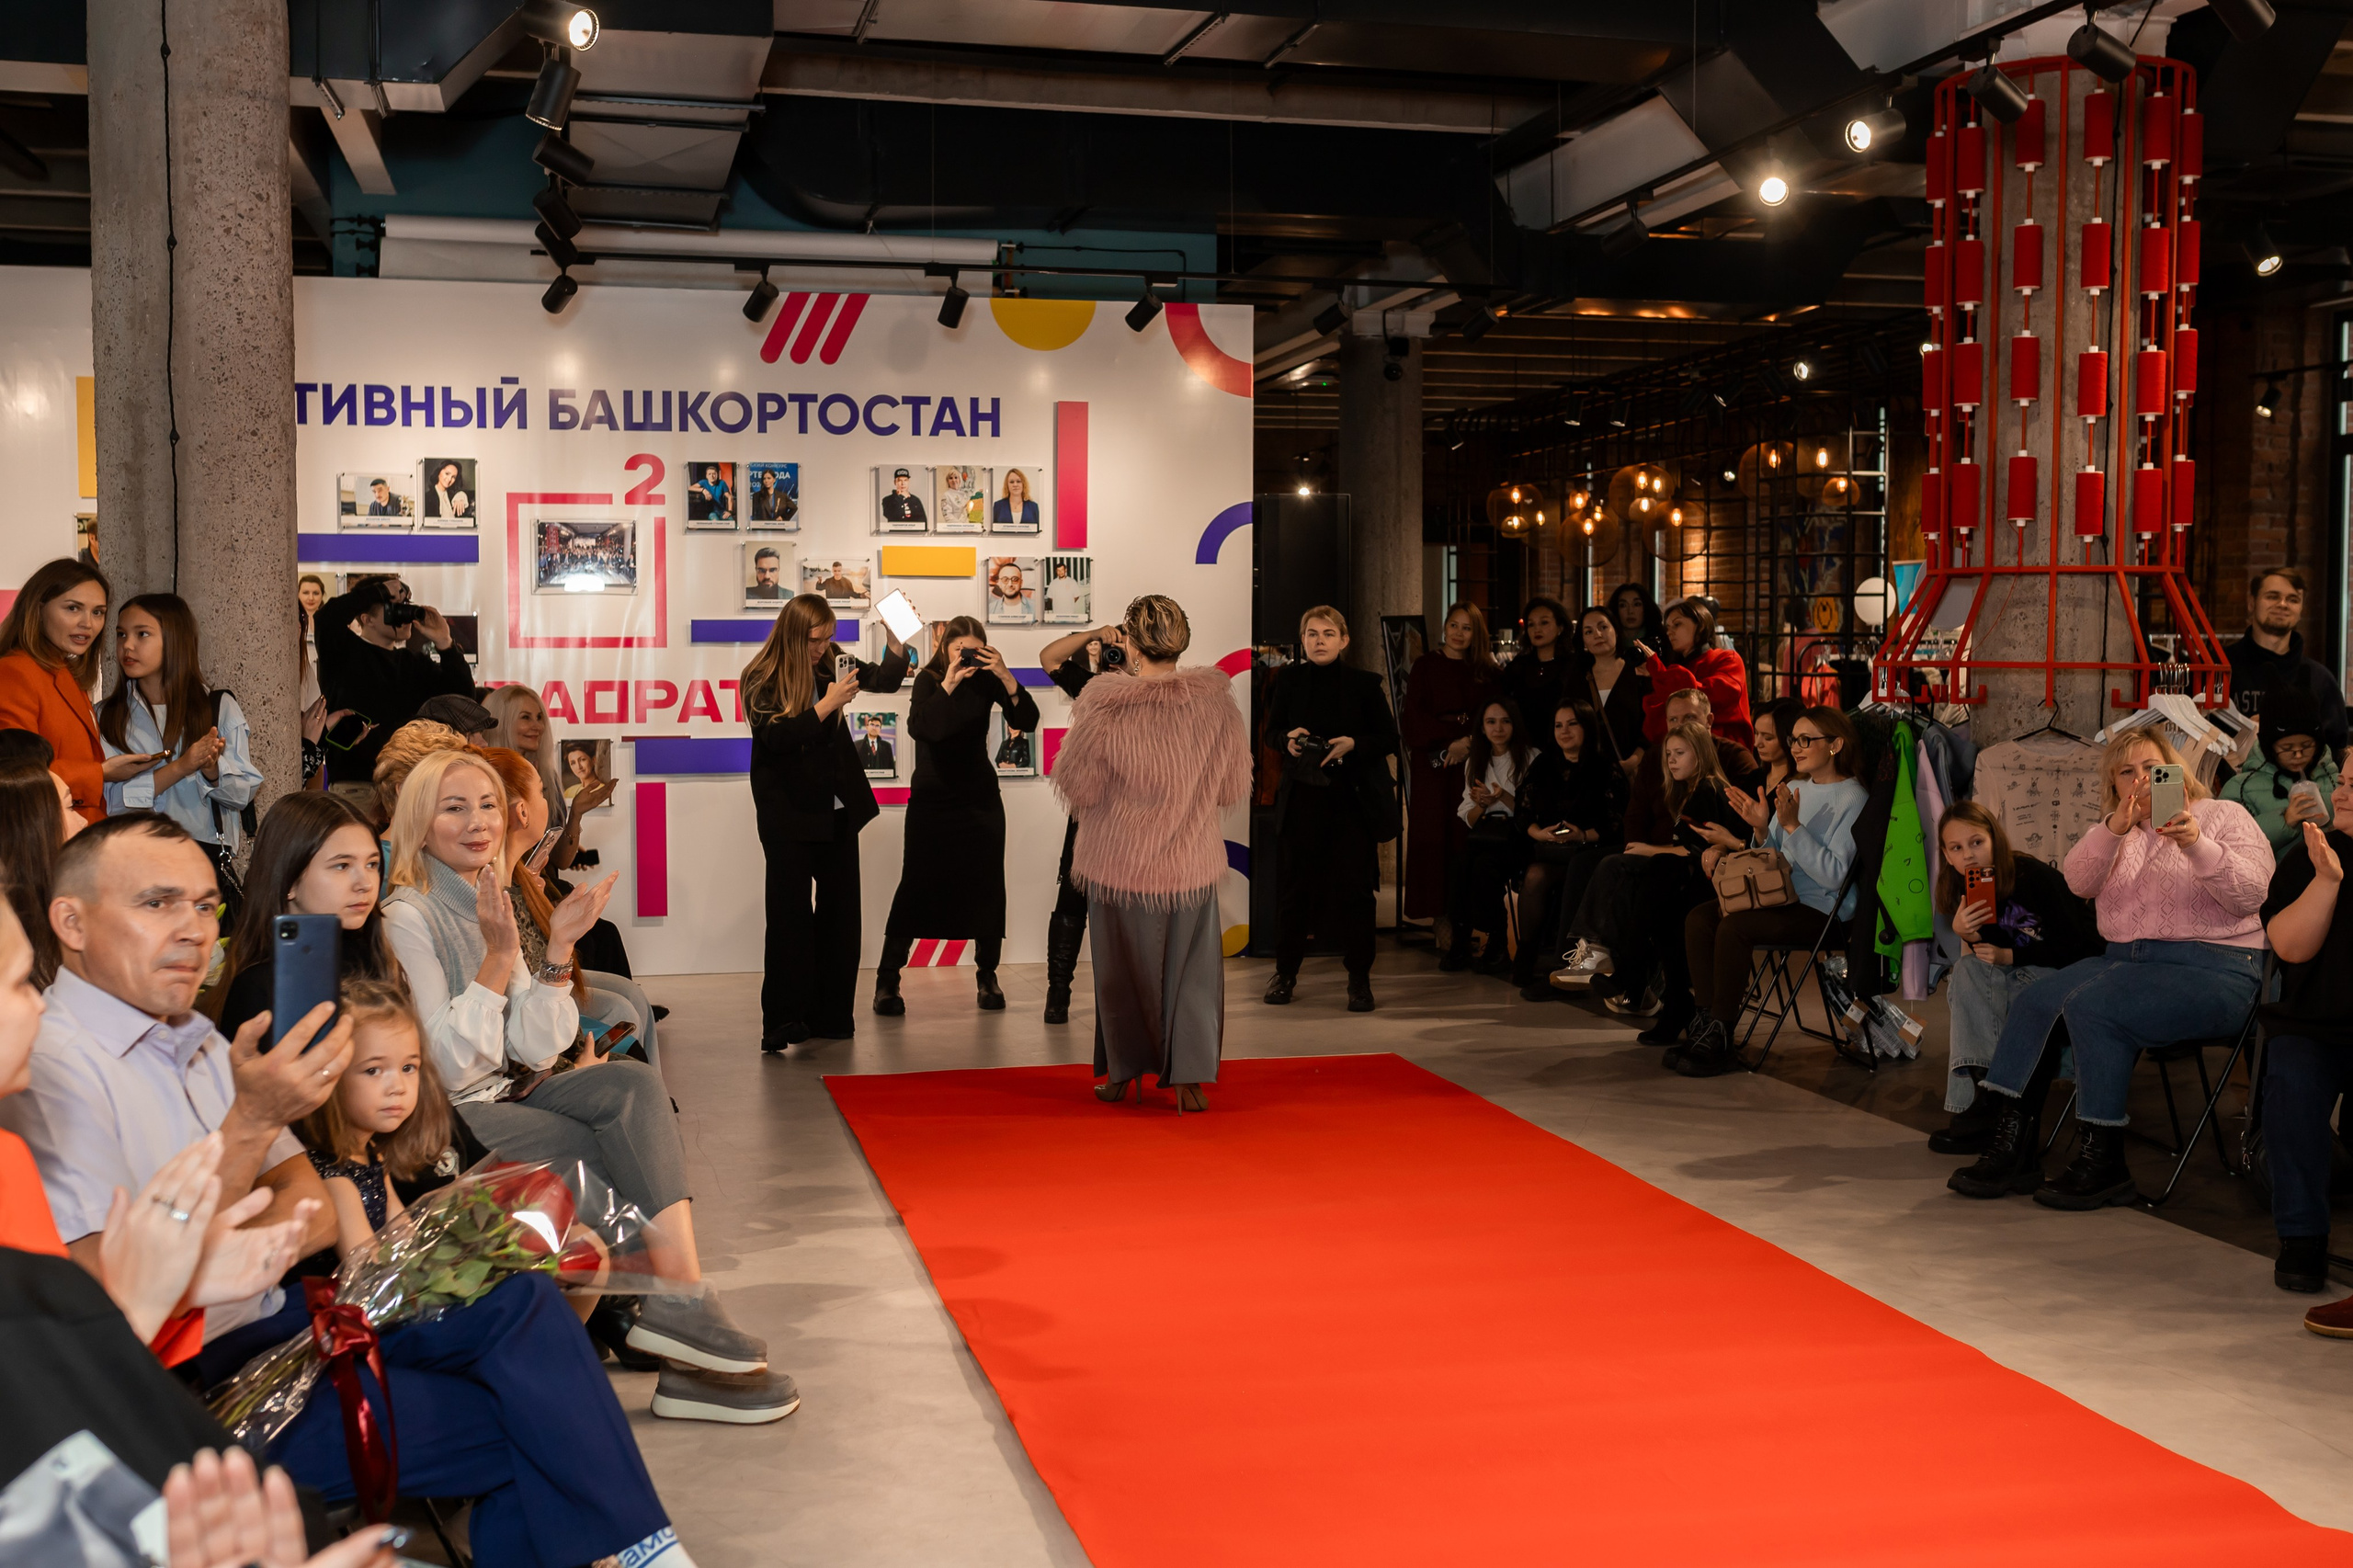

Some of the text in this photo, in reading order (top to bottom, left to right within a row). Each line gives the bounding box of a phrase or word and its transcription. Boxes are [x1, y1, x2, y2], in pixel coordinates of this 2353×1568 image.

[294, 377, 1001, 437] ТИВНЫЙ БАШКОРТОСТАН
[623, 452, 666, 506] 2
[750, 471, 763, 479] РТЕ
[2234, 690, 2267, 712] AST
